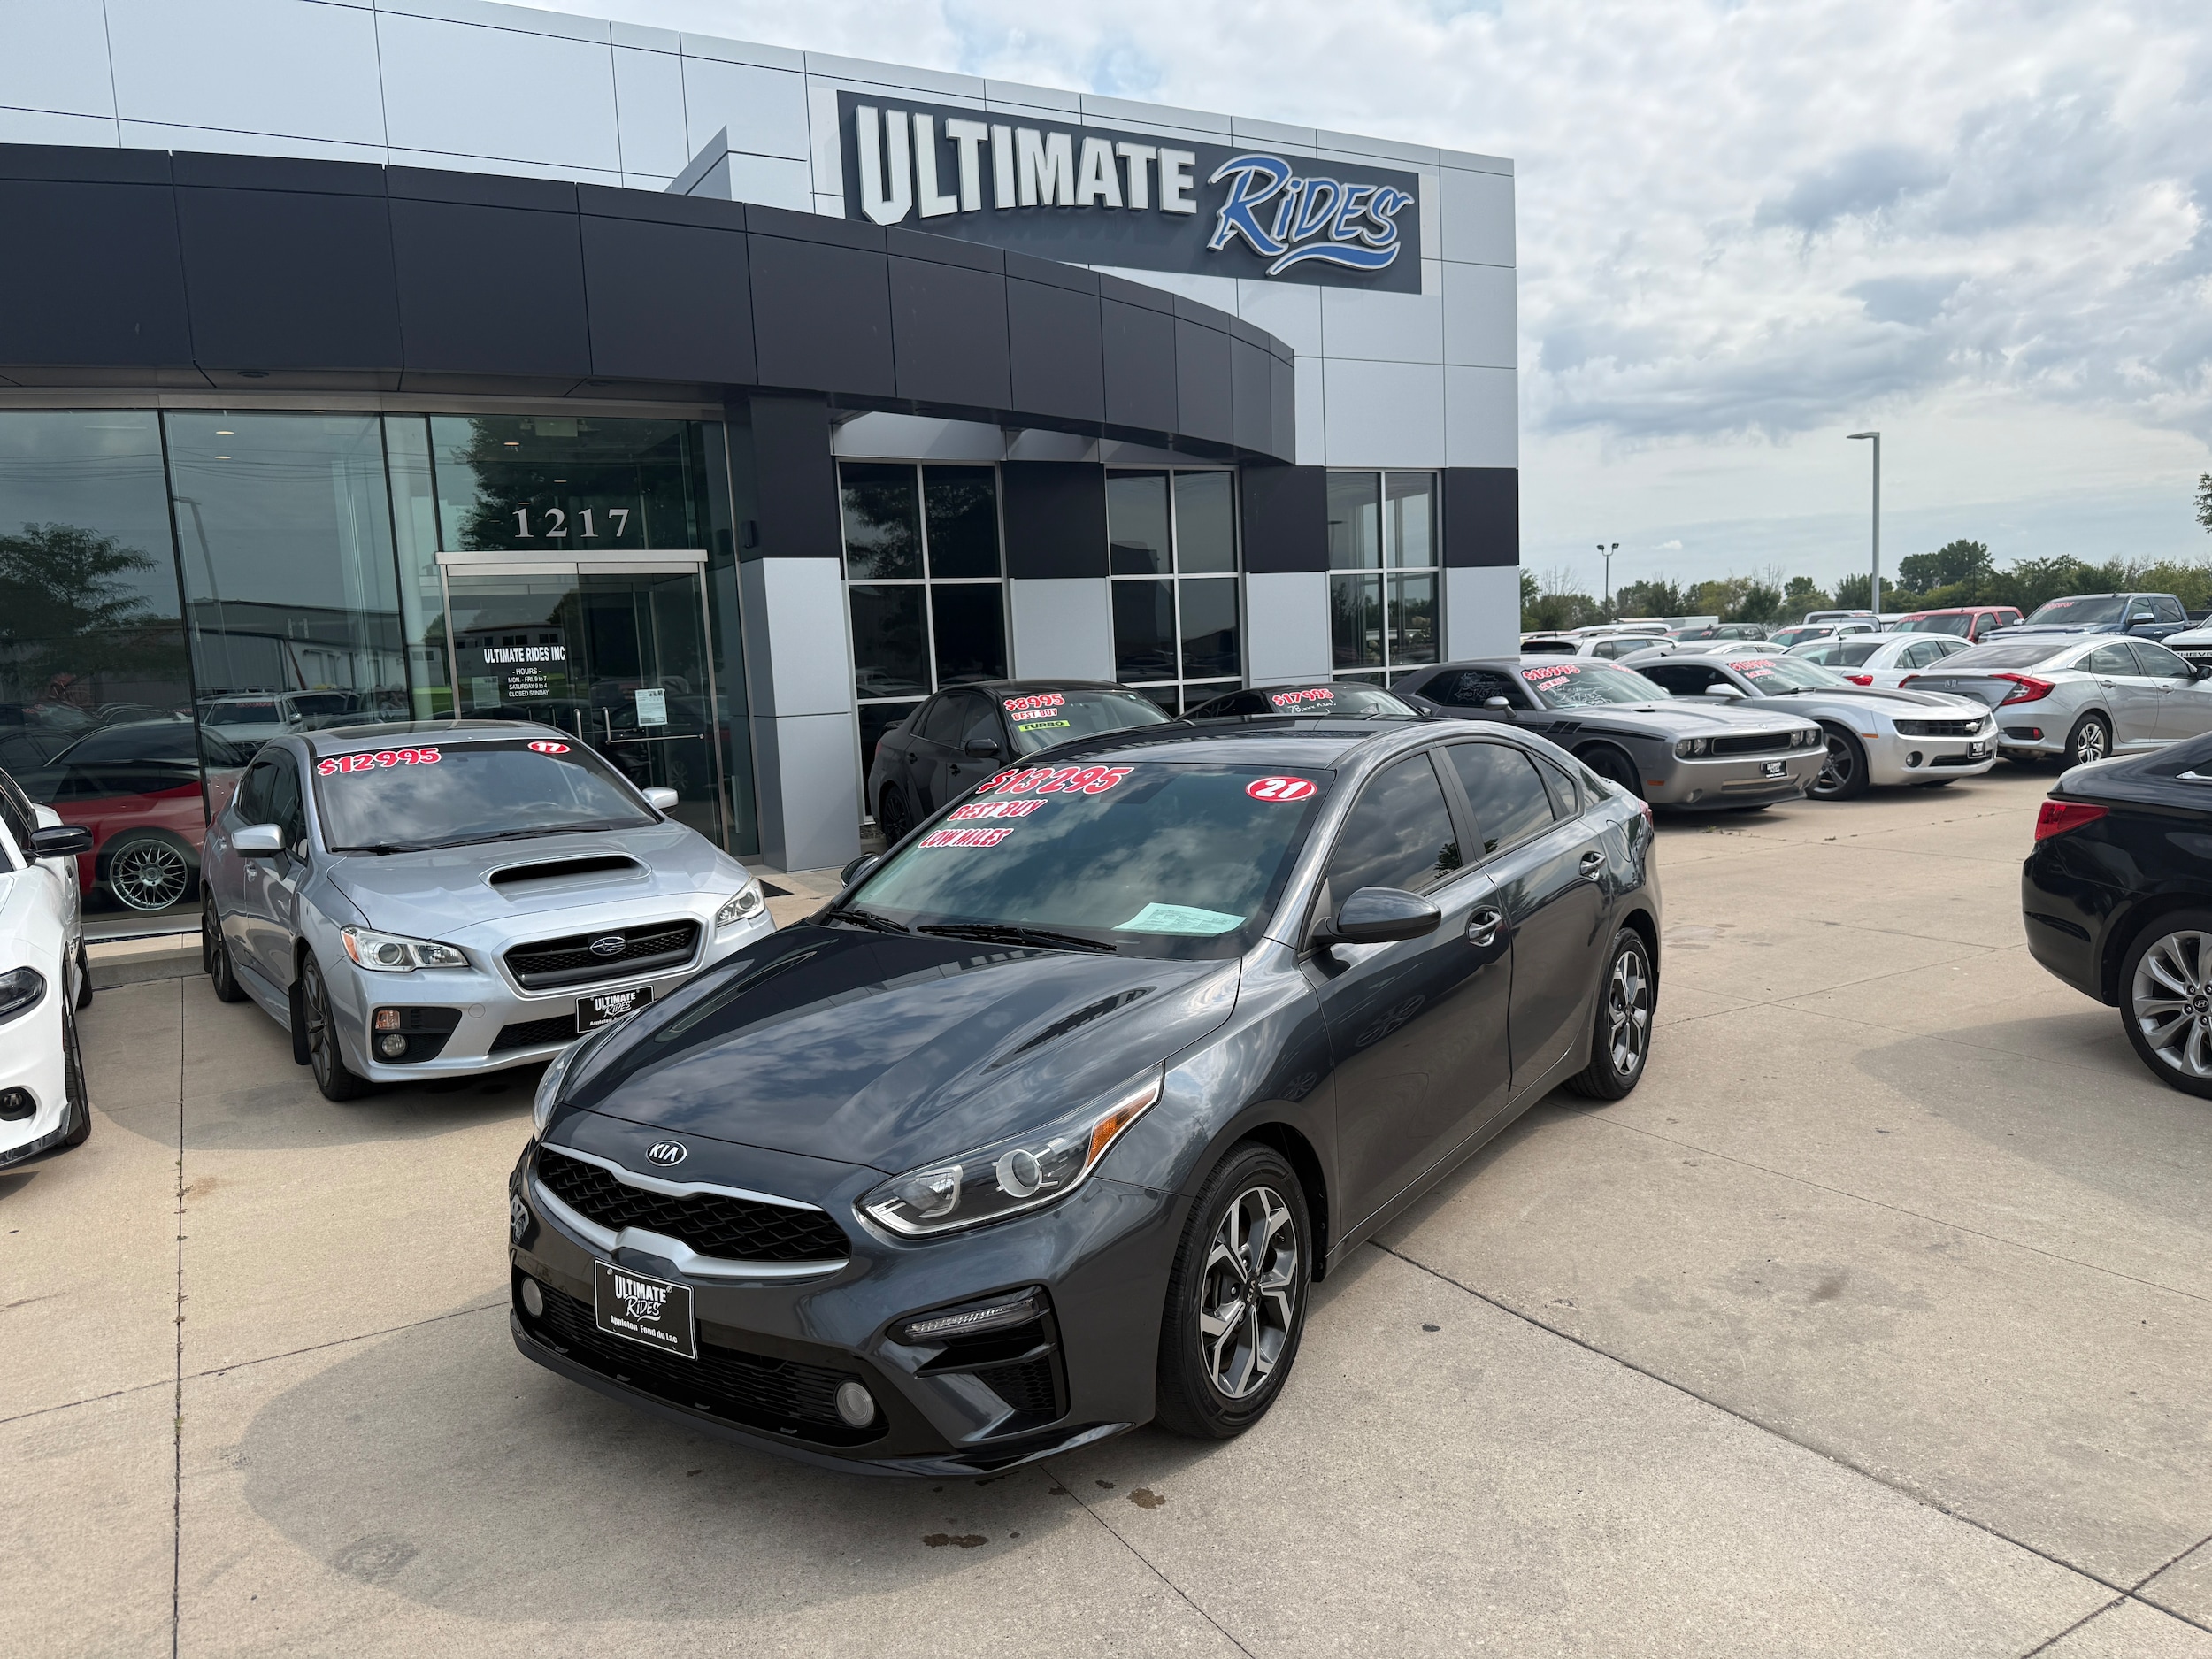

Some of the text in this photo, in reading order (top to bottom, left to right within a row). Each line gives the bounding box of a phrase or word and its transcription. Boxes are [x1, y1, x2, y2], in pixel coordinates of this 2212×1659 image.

[855, 104, 1198, 226] ULTIMATE
[512, 508, 629, 537] 1217
[483, 646, 565, 664] ULTIMATE RIDES INC
[1537, 681, 1552, 692] LOW
[1003, 694, 1065, 711] $8995
[1272, 688, 1334, 706] $17995
[1012, 708, 1058, 721] BEST BUY
[1022, 721, 1065, 730] TURBO
[536, 742, 562, 753] 17
[317, 747, 442, 776] $12995
[975, 766, 1135, 795] $13295
[1255, 779, 1308, 798] 21
[947, 799, 1048, 821] BEST BUY
[918, 828, 1014, 849] LOW MILES
[595, 992, 636, 1011] ULTIMATE
[649, 1143, 679, 1162] KIA
[614, 1274, 667, 1303] ULTIMATE
[610, 1315, 678, 1343] Appleton Fond du Lac
